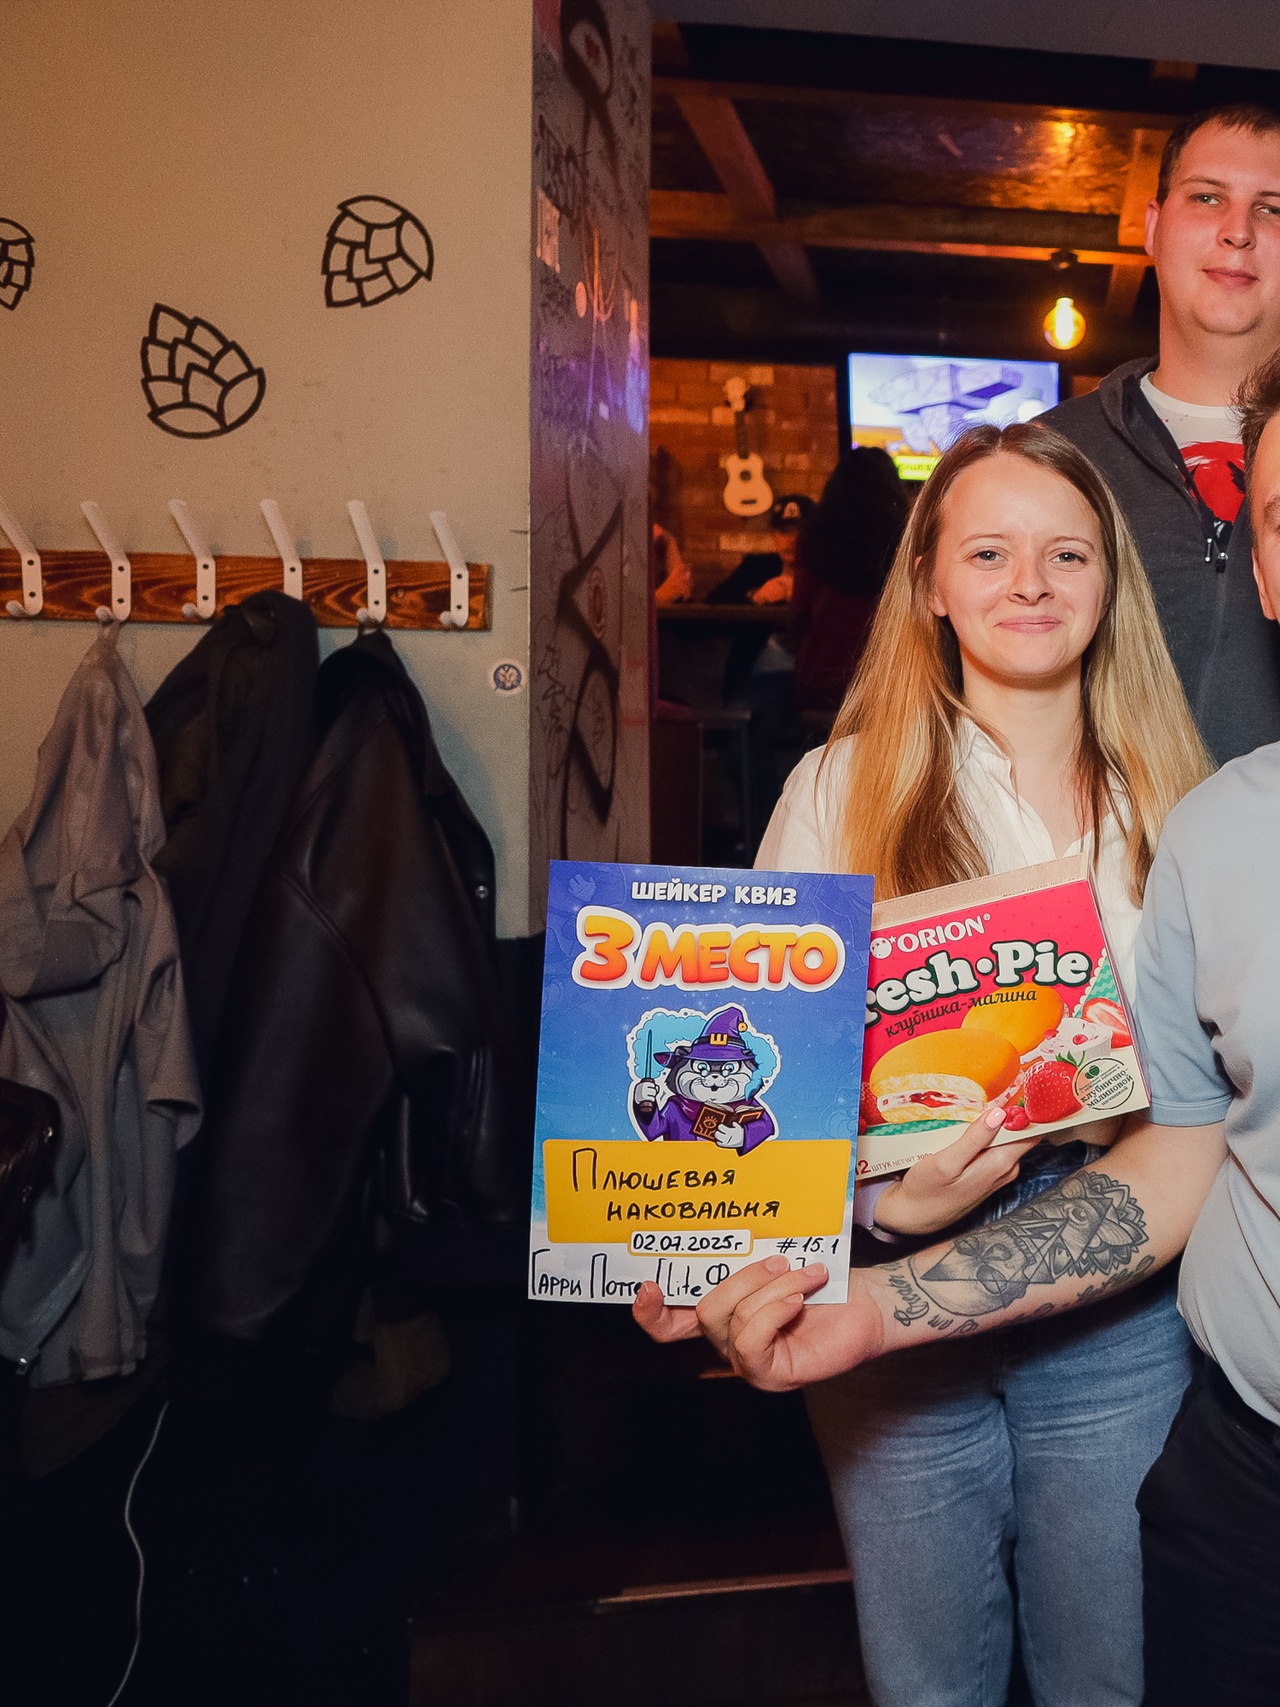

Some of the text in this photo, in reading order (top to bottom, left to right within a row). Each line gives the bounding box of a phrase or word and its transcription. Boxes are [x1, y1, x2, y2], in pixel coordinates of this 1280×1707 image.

[631, 878, 797, 906] ШЕЙКЕР КВИЗ
[578, 914, 839, 985] 3 МЕСТО
[897, 915, 985, 953] ORION
[885, 990, 1037, 1037] клубника-малина
[632, 1233, 743, 1252] 02.07.2025г
